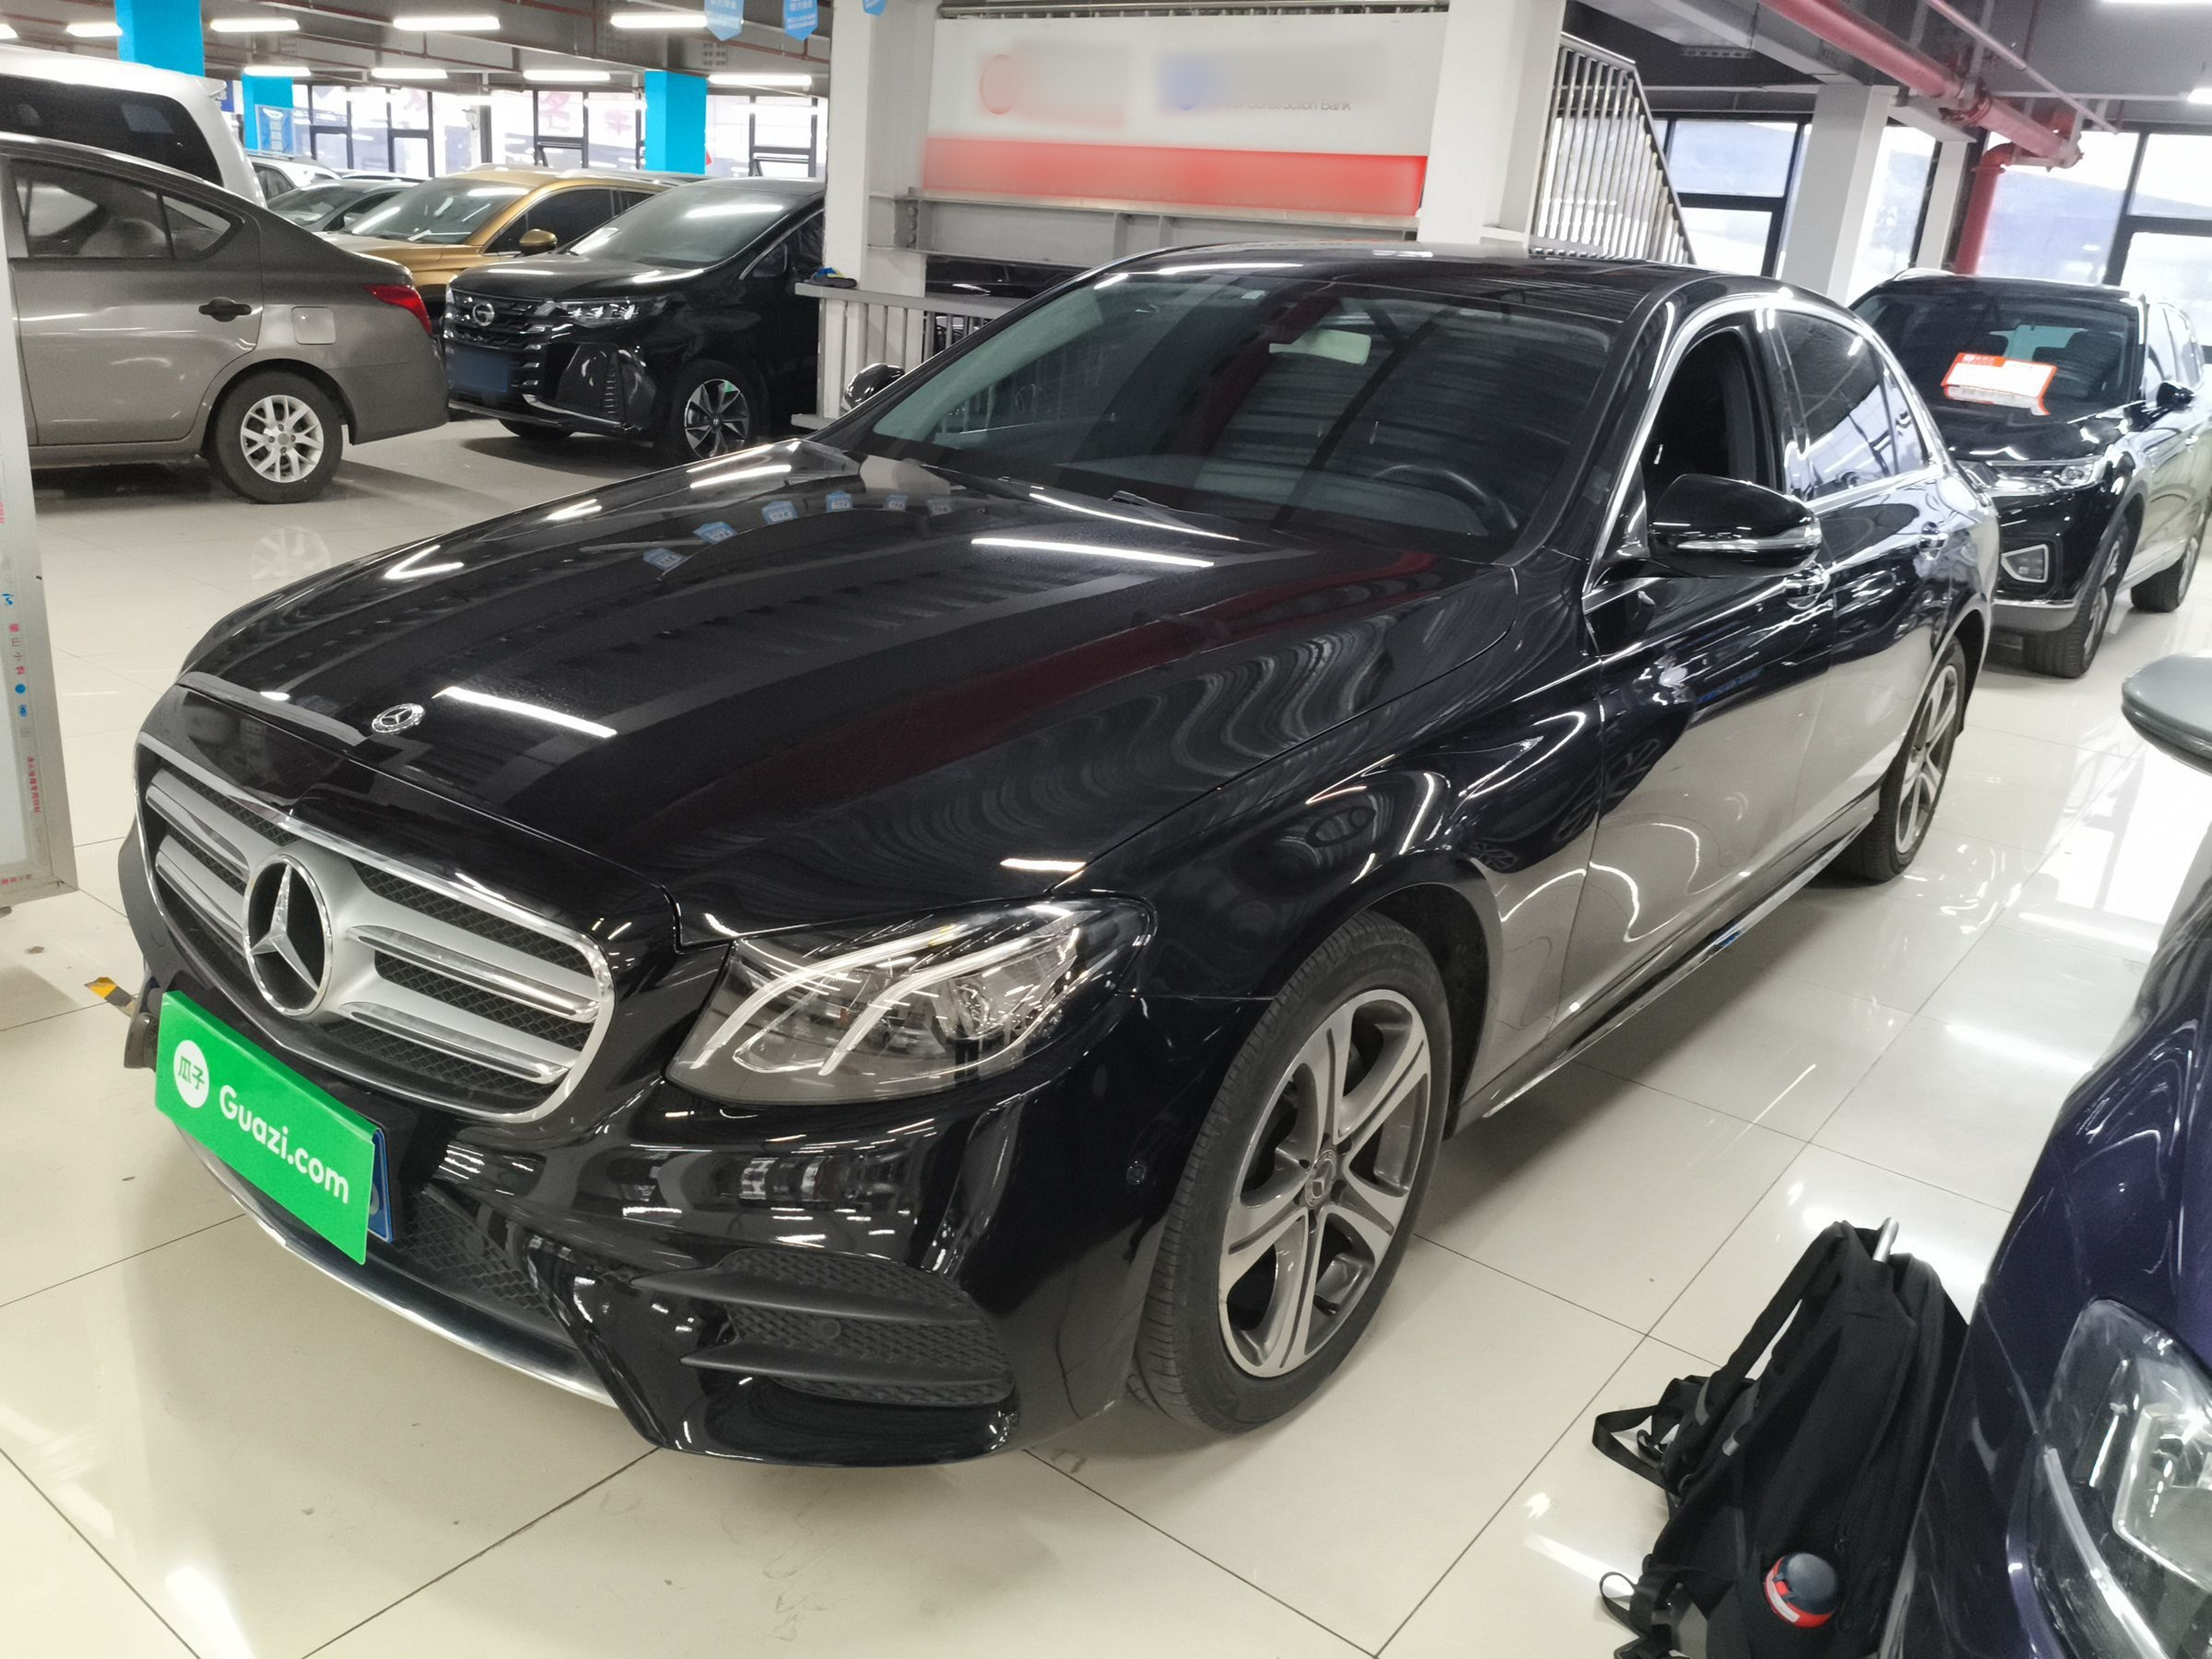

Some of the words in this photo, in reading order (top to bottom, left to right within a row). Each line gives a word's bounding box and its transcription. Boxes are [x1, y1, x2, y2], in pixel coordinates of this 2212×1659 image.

[1320, 99, 1352, 111] Bank
[178, 1056, 204, 1090] 瓜子
[220, 1084, 349, 1203] Guazi.com
